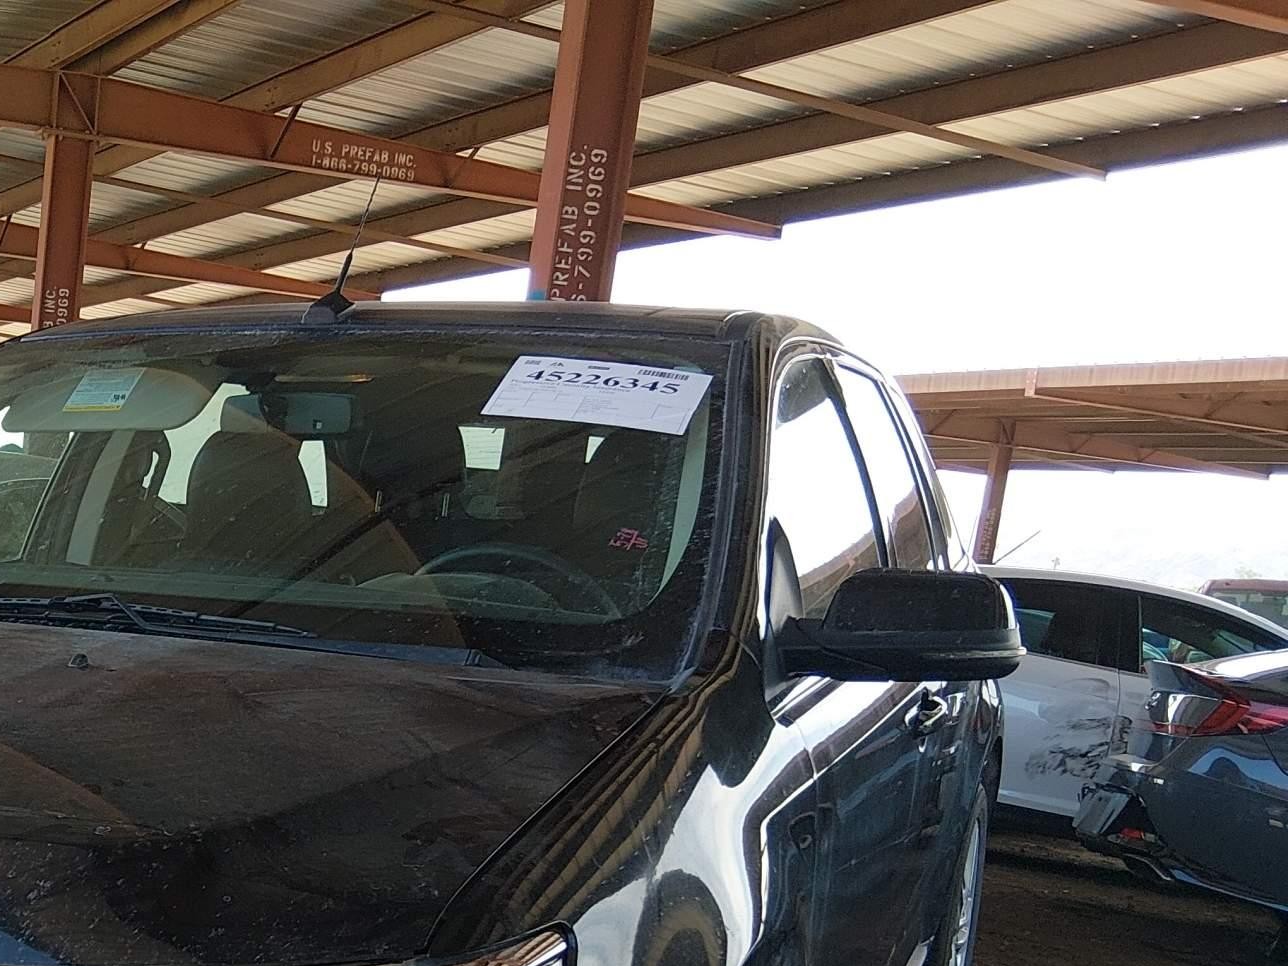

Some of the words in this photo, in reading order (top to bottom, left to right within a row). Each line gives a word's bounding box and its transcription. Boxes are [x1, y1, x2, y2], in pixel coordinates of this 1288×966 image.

[312, 139, 336, 156] U.S.
[341, 144, 390, 164] PREFAB
[395, 152, 417, 168] INC.
[312, 155, 416, 181] 1-866-799-0969
[550, 205, 579, 301] PREFAB
[566, 144, 589, 191] INC.
[44, 286, 57, 313] INC.
[526, 369, 682, 395] 45226345
